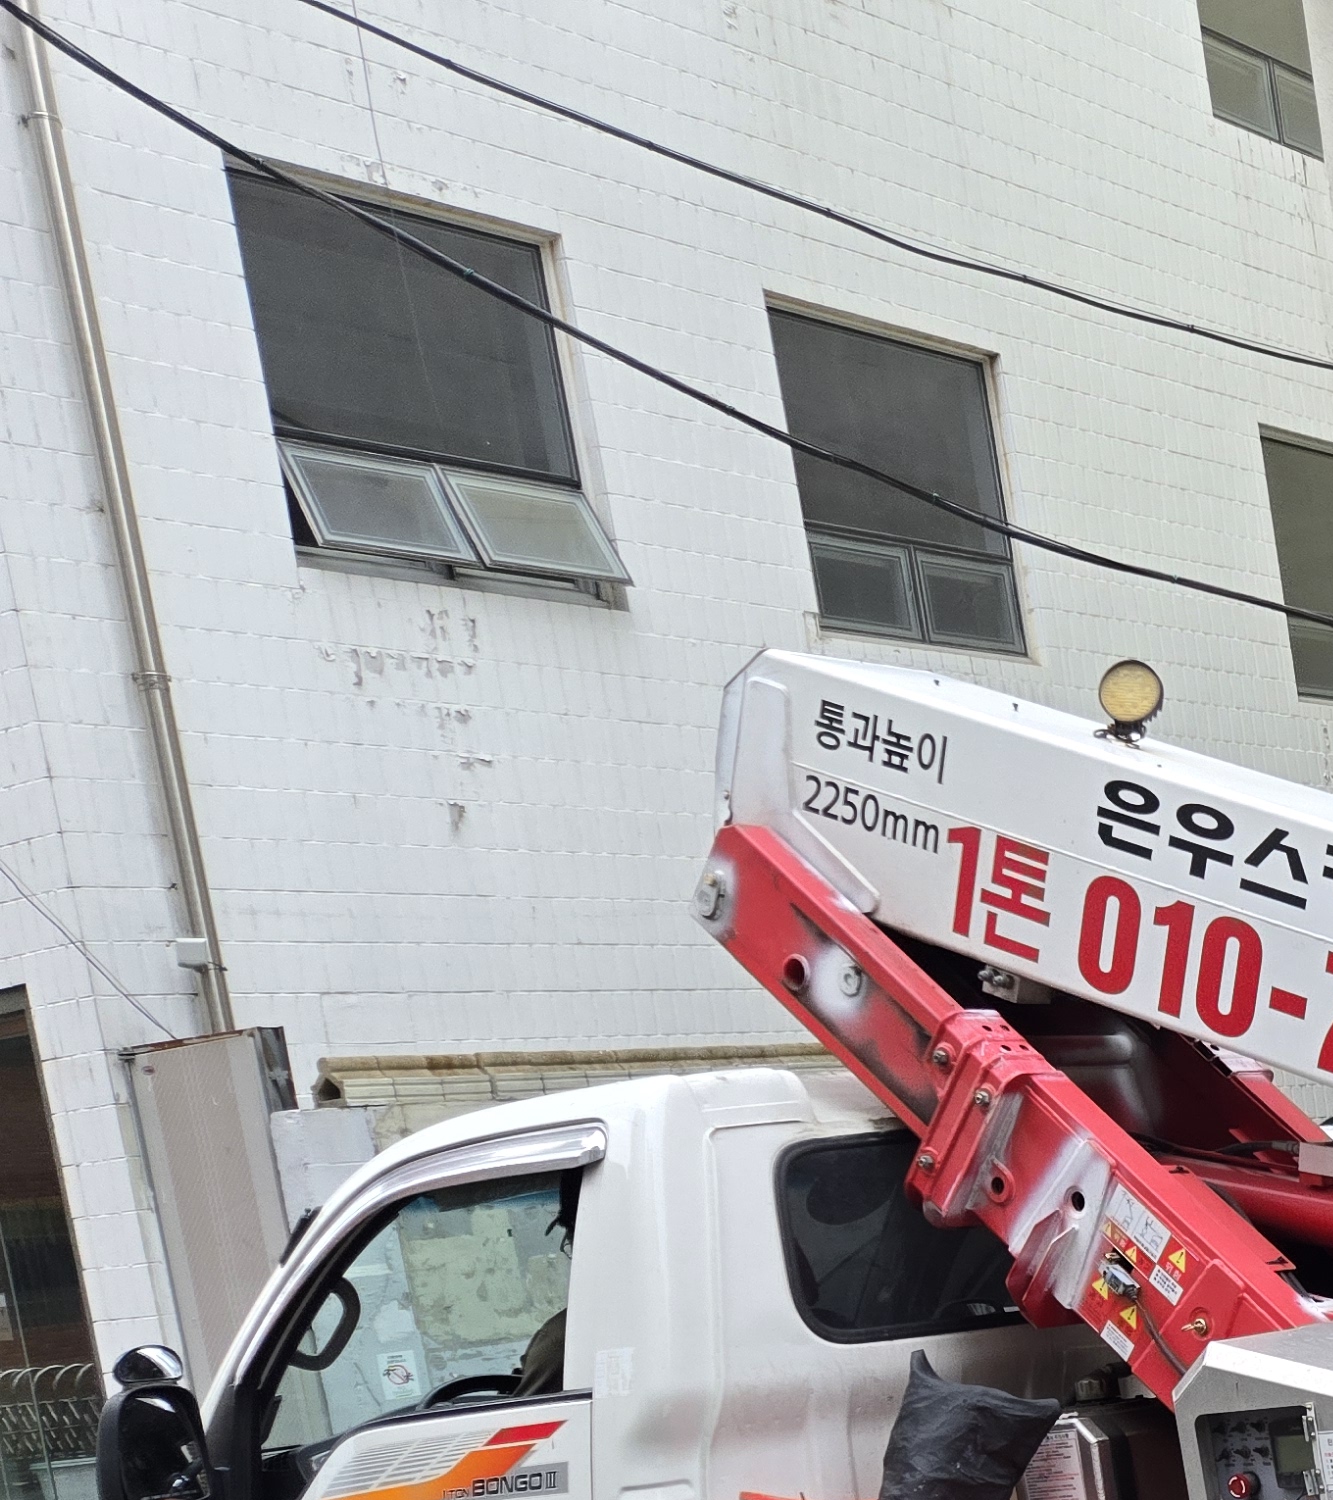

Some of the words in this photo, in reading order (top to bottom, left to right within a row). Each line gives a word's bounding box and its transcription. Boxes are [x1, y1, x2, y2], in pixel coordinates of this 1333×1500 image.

[814, 698, 948, 786] 통과높이
[804, 774, 942, 855] 2250mm
[947, 826, 1053, 964] 1톤
[472, 1472, 543, 1497] BONGO
